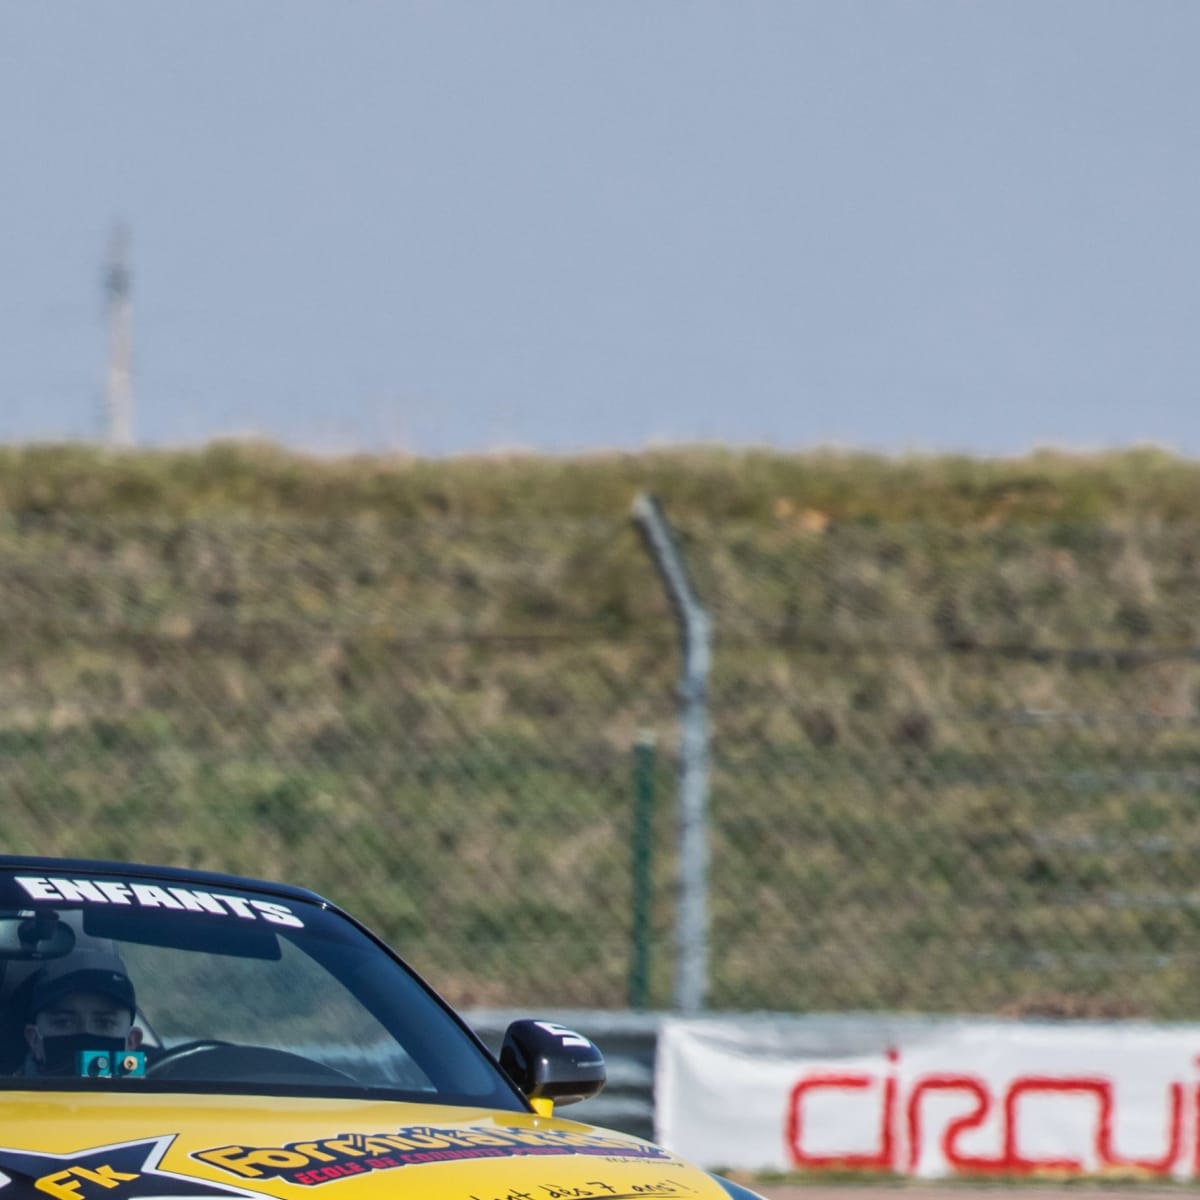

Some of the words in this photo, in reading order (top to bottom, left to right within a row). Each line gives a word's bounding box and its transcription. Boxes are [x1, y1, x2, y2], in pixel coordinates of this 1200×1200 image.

[14, 876, 305, 928] ENFANTS
[195, 1126, 517, 1178] Formula
[538, 1183, 594, 1199] dès
[586, 1181, 616, 1194] 7
